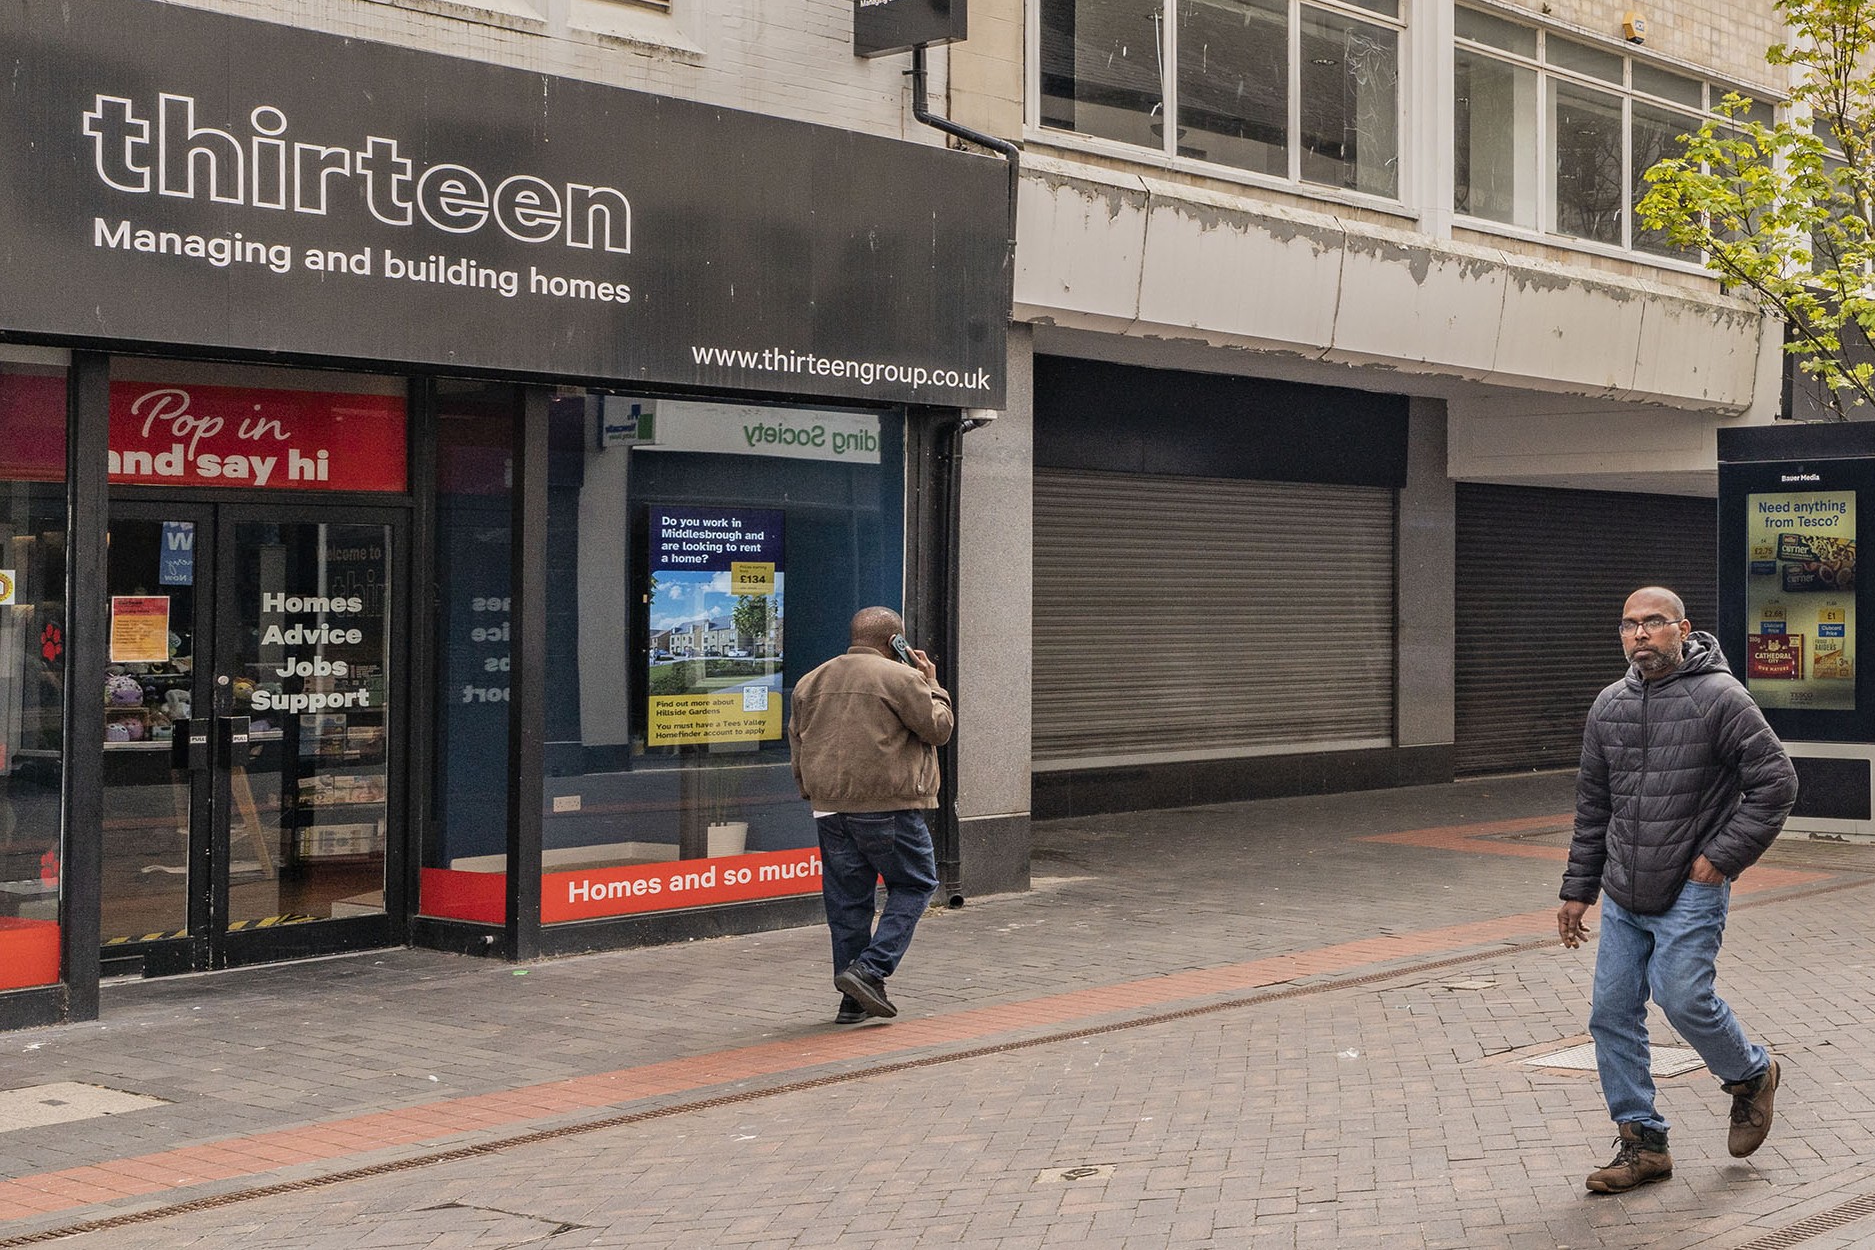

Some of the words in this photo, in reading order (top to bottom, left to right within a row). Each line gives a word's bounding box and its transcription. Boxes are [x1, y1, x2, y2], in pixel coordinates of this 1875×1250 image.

[83, 92, 631, 254] thirteen
[94, 217, 292, 274] Managing
[304, 246, 371, 276] and
[384, 249, 518, 298] building
[530, 266, 631, 303] homes
[692, 346, 990, 390] www.thirteengroup.co.uk
[131, 388, 225, 461] Pop
[238, 404, 291, 441] in
[196, 453, 277, 486] say
[288, 449, 329, 481] hi
[1800, 473, 1820, 481] Media
[1758, 501, 1790, 513] Need
[1794, 500, 1847, 514] anything
[661, 516, 677, 526] Do
[680, 518, 700, 528] you
[703, 518, 728, 527] work
[731, 518, 742, 527] in
[1765, 516, 1794, 528] from
[1798, 515, 1840, 527] Tesco?
[661, 529, 742, 542] Middlesbrough
[744, 531, 764, 540] and
[661, 542, 680, 551] are
[682, 541, 723, 553] looking
[726, 543, 737, 552] to
[740, 543, 761, 552] rent
[661, 555, 668, 563] a
[671, 554, 709, 563] home?
[740, 575, 766, 584] £134
[262, 592, 363, 613] Homes
[1827, 612, 1836, 620] £1
[261, 623, 363, 645] Advice
[1755, 652, 1792, 660] CATHEDRAL
[276, 655, 348, 678] Jobs
[250, 688, 369, 714] Support
[656, 709, 687, 717] Hillside
[689, 708, 720, 716] Gardens
[695, 721, 713, 729] have
[743, 719, 766, 727] Valley
[656, 731, 701, 739] Homefinder
[703, 729, 733, 737] account
[745, 728, 765, 736] apply
[568, 876, 662, 903] Homes
[669, 865, 716, 892] and
[723, 867, 752, 886] so
[759, 854, 823, 882] much
